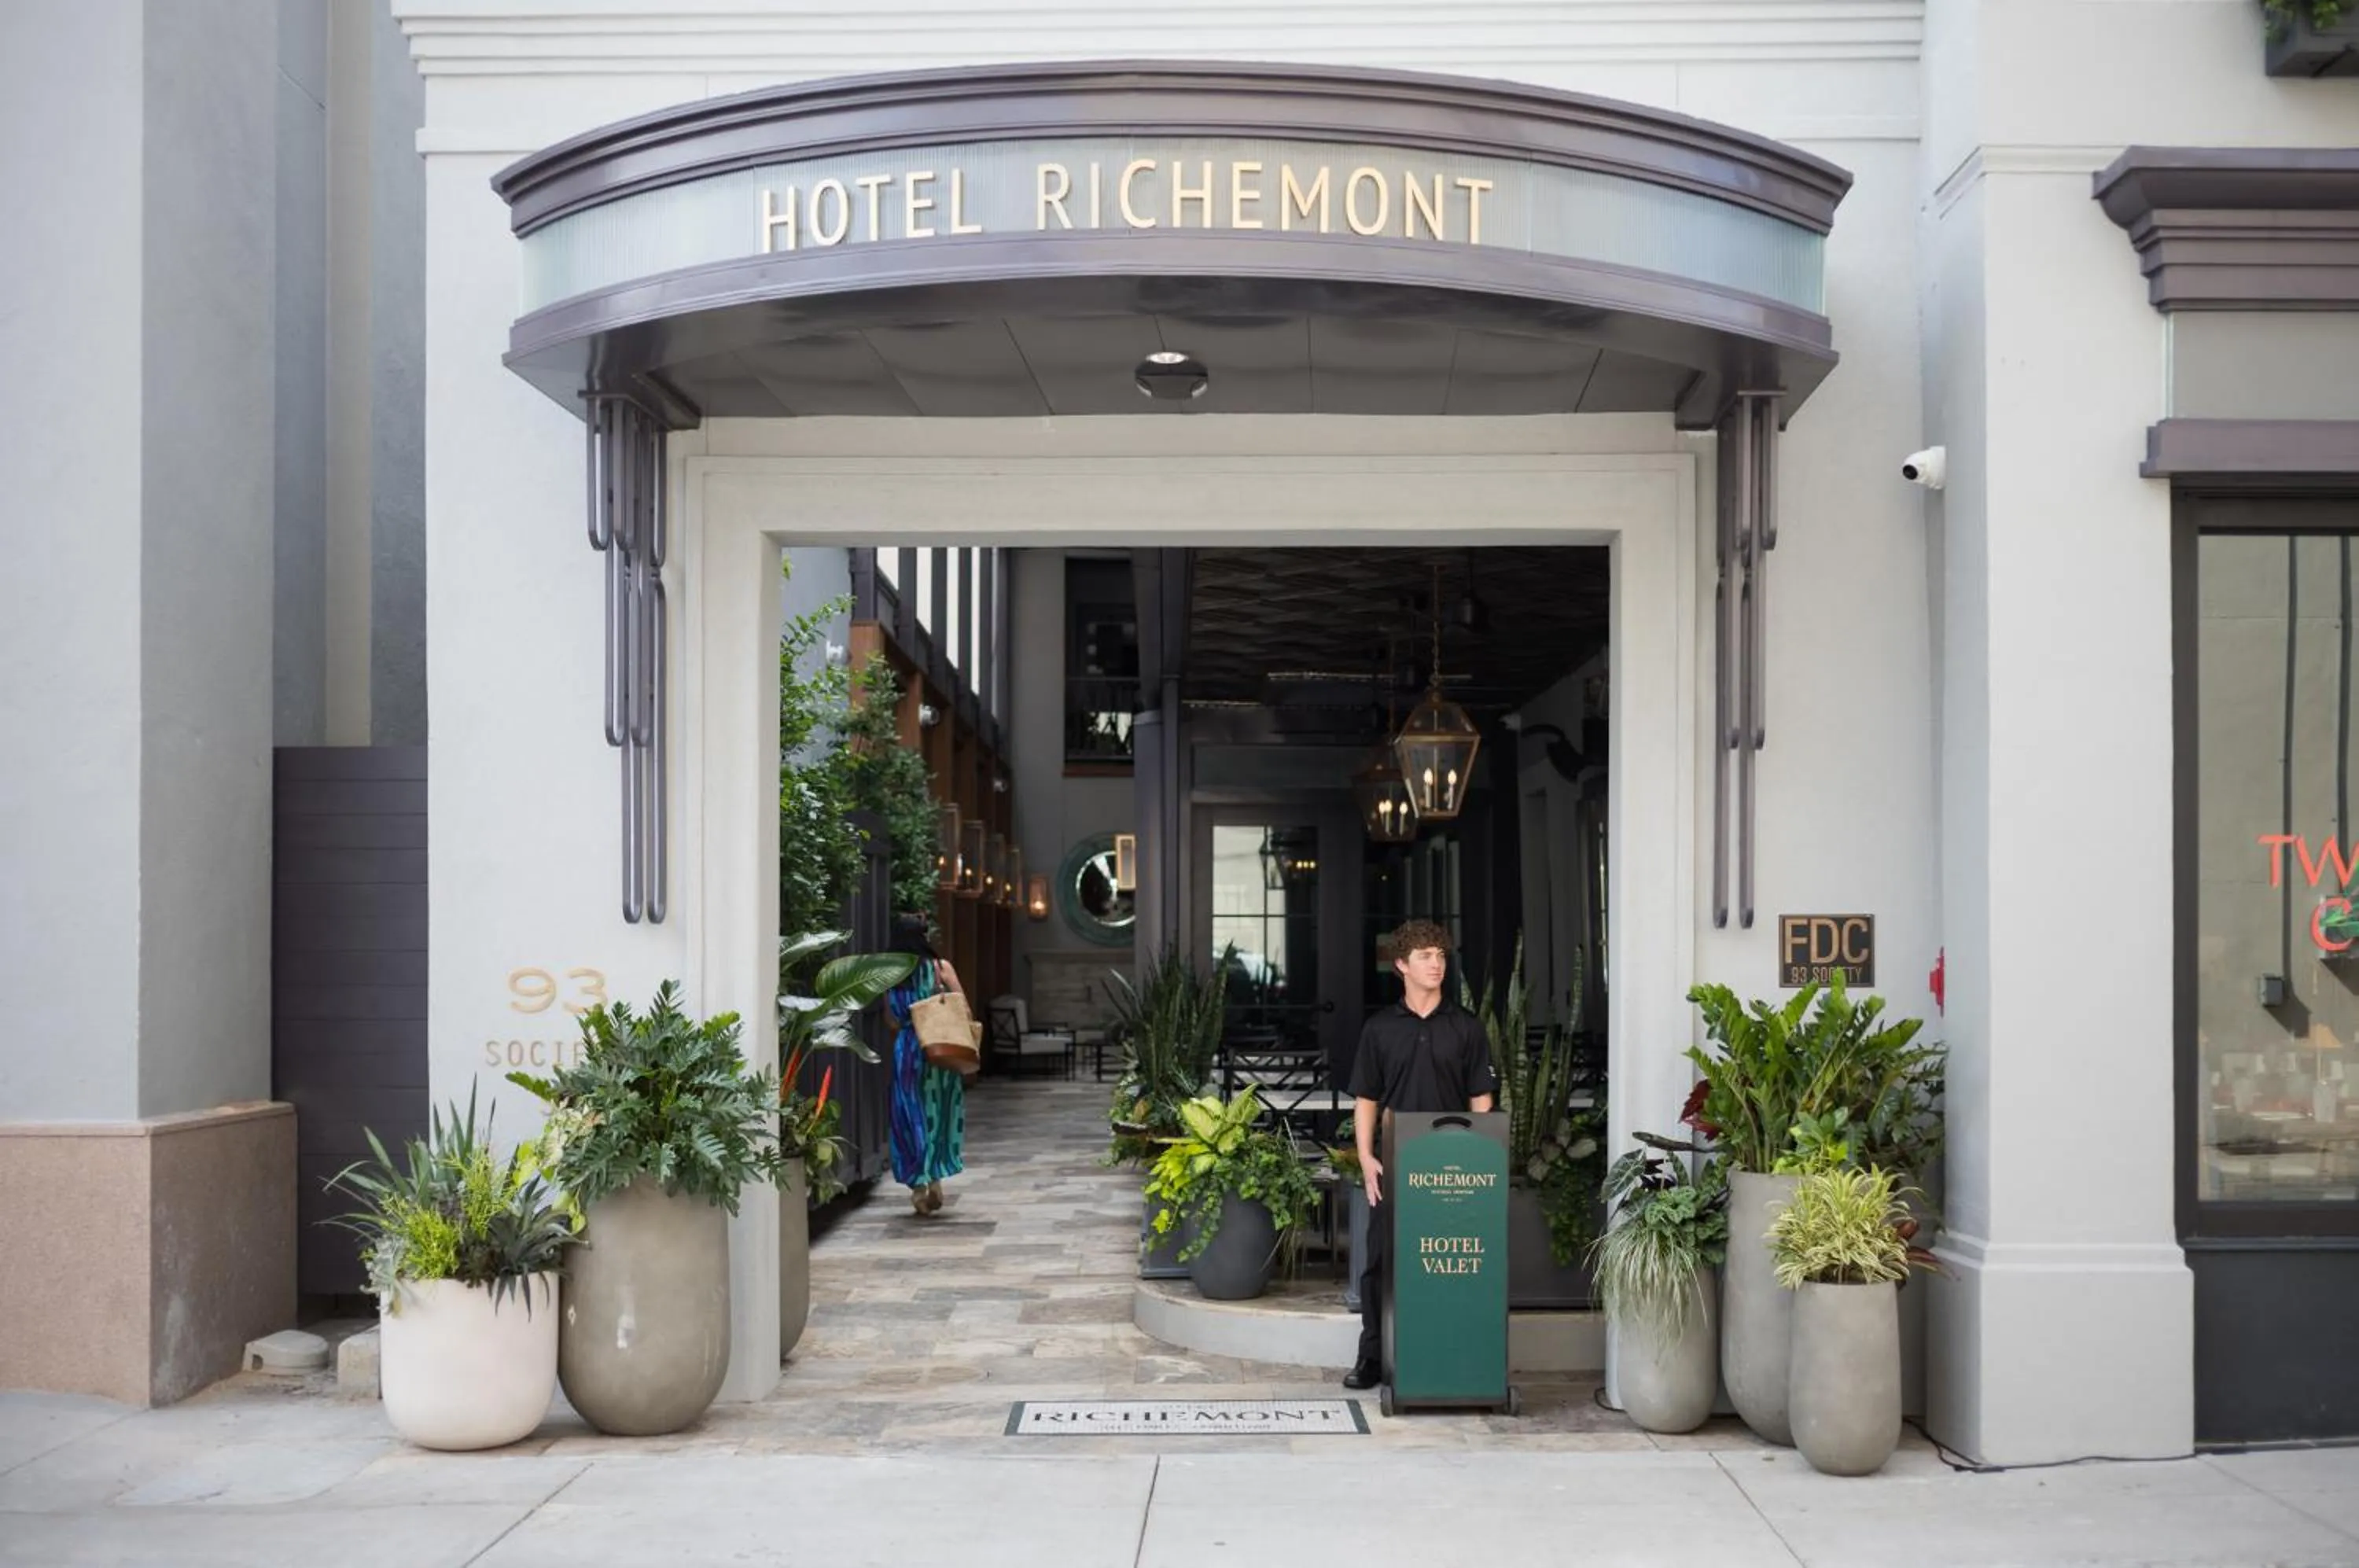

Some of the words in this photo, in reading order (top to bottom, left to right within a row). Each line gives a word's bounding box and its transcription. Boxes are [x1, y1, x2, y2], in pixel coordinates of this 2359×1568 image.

[762, 167, 983, 254] HOTEL
[1036, 159, 1493, 245] RICHEMONT
[1784, 918, 1870, 964] FDC
[1791, 966, 1808, 983] 93
[1812, 966, 1862, 983] SOTY
[507, 966, 609, 1015] 93
[484, 1040, 585, 1068] SOCI
[1408, 1172, 1497, 1188] RICHEMONT
[1419, 1236, 1485, 1253] HOTEL
[1422, 1257, 1482, 1274] VALET
[1032, 1409, 1341, 1423] RICHEMONT
